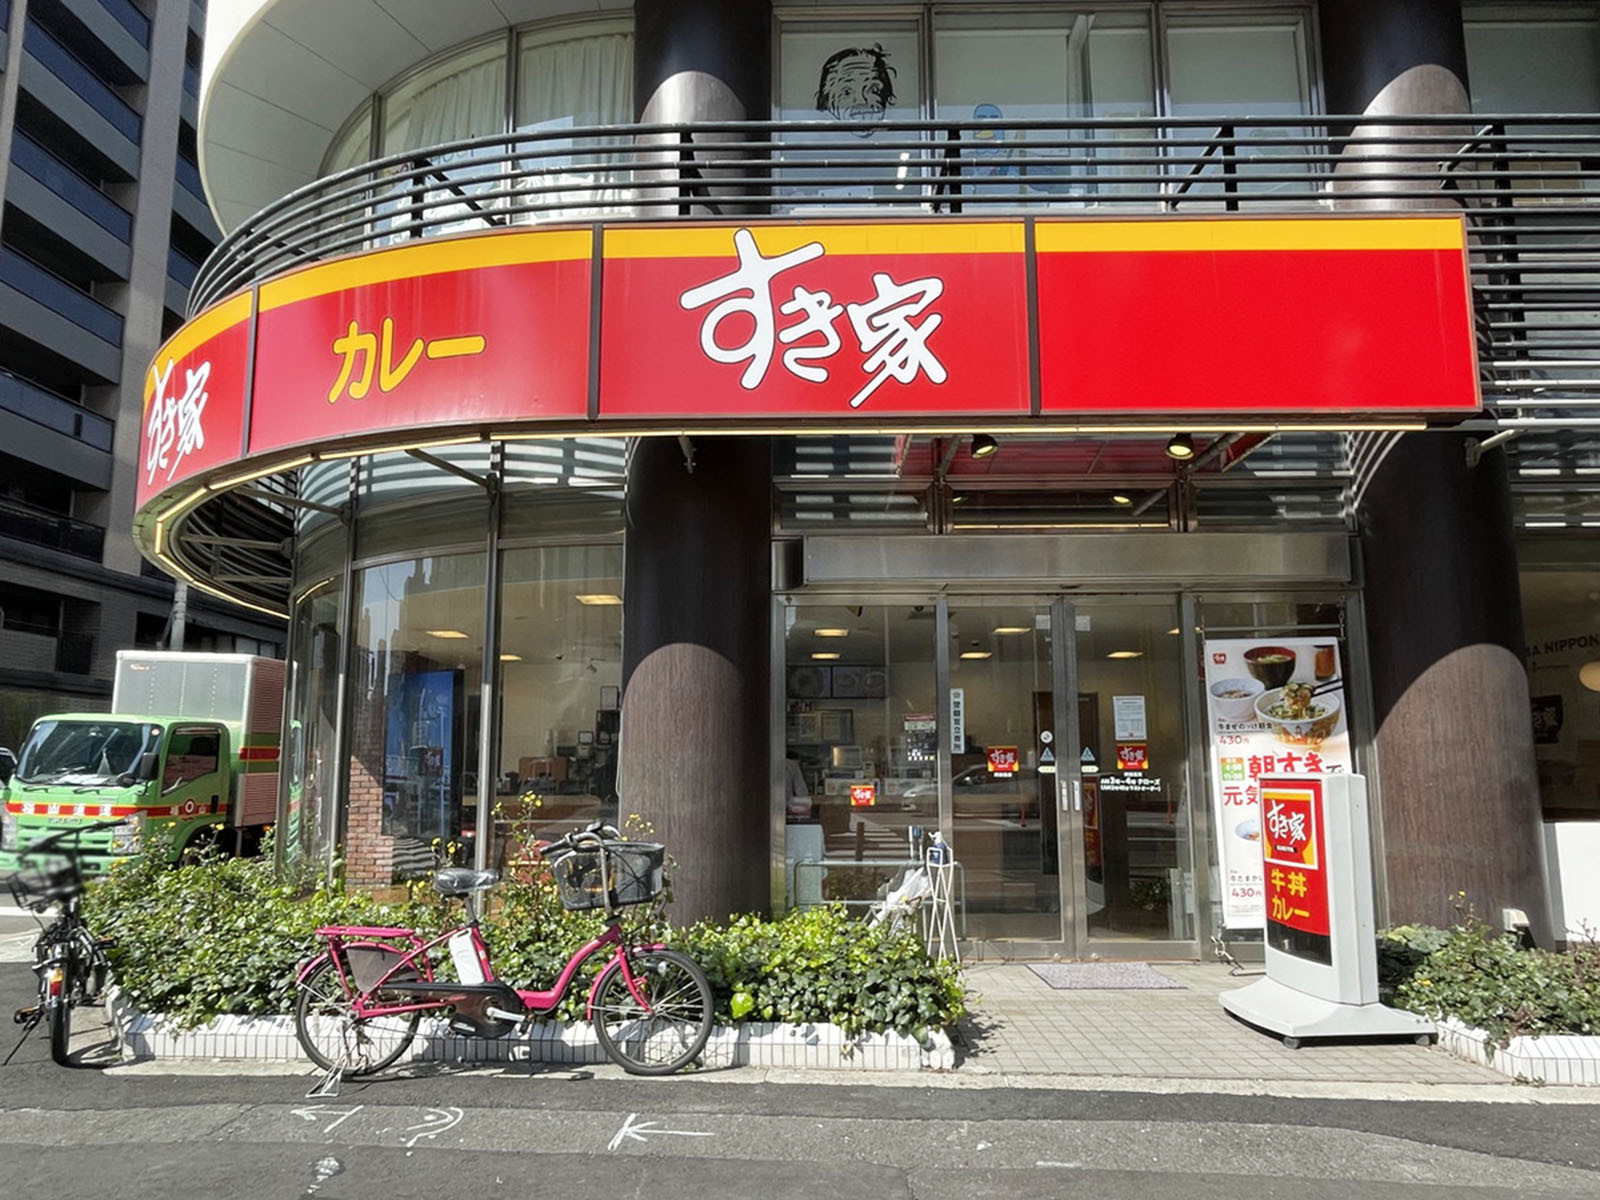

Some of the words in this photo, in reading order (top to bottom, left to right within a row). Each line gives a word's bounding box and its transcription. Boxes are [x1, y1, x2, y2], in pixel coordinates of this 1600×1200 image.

[680, 227, 949, 408] すき家
[328, 316, 486, 405] カレー
[145, 356, 212, 486] すき家
[1266, 799, 1307, 845] すき家
[1271, 868, 1308, 898] 牛丼
[1271, 895, 1310, 921] カレー
